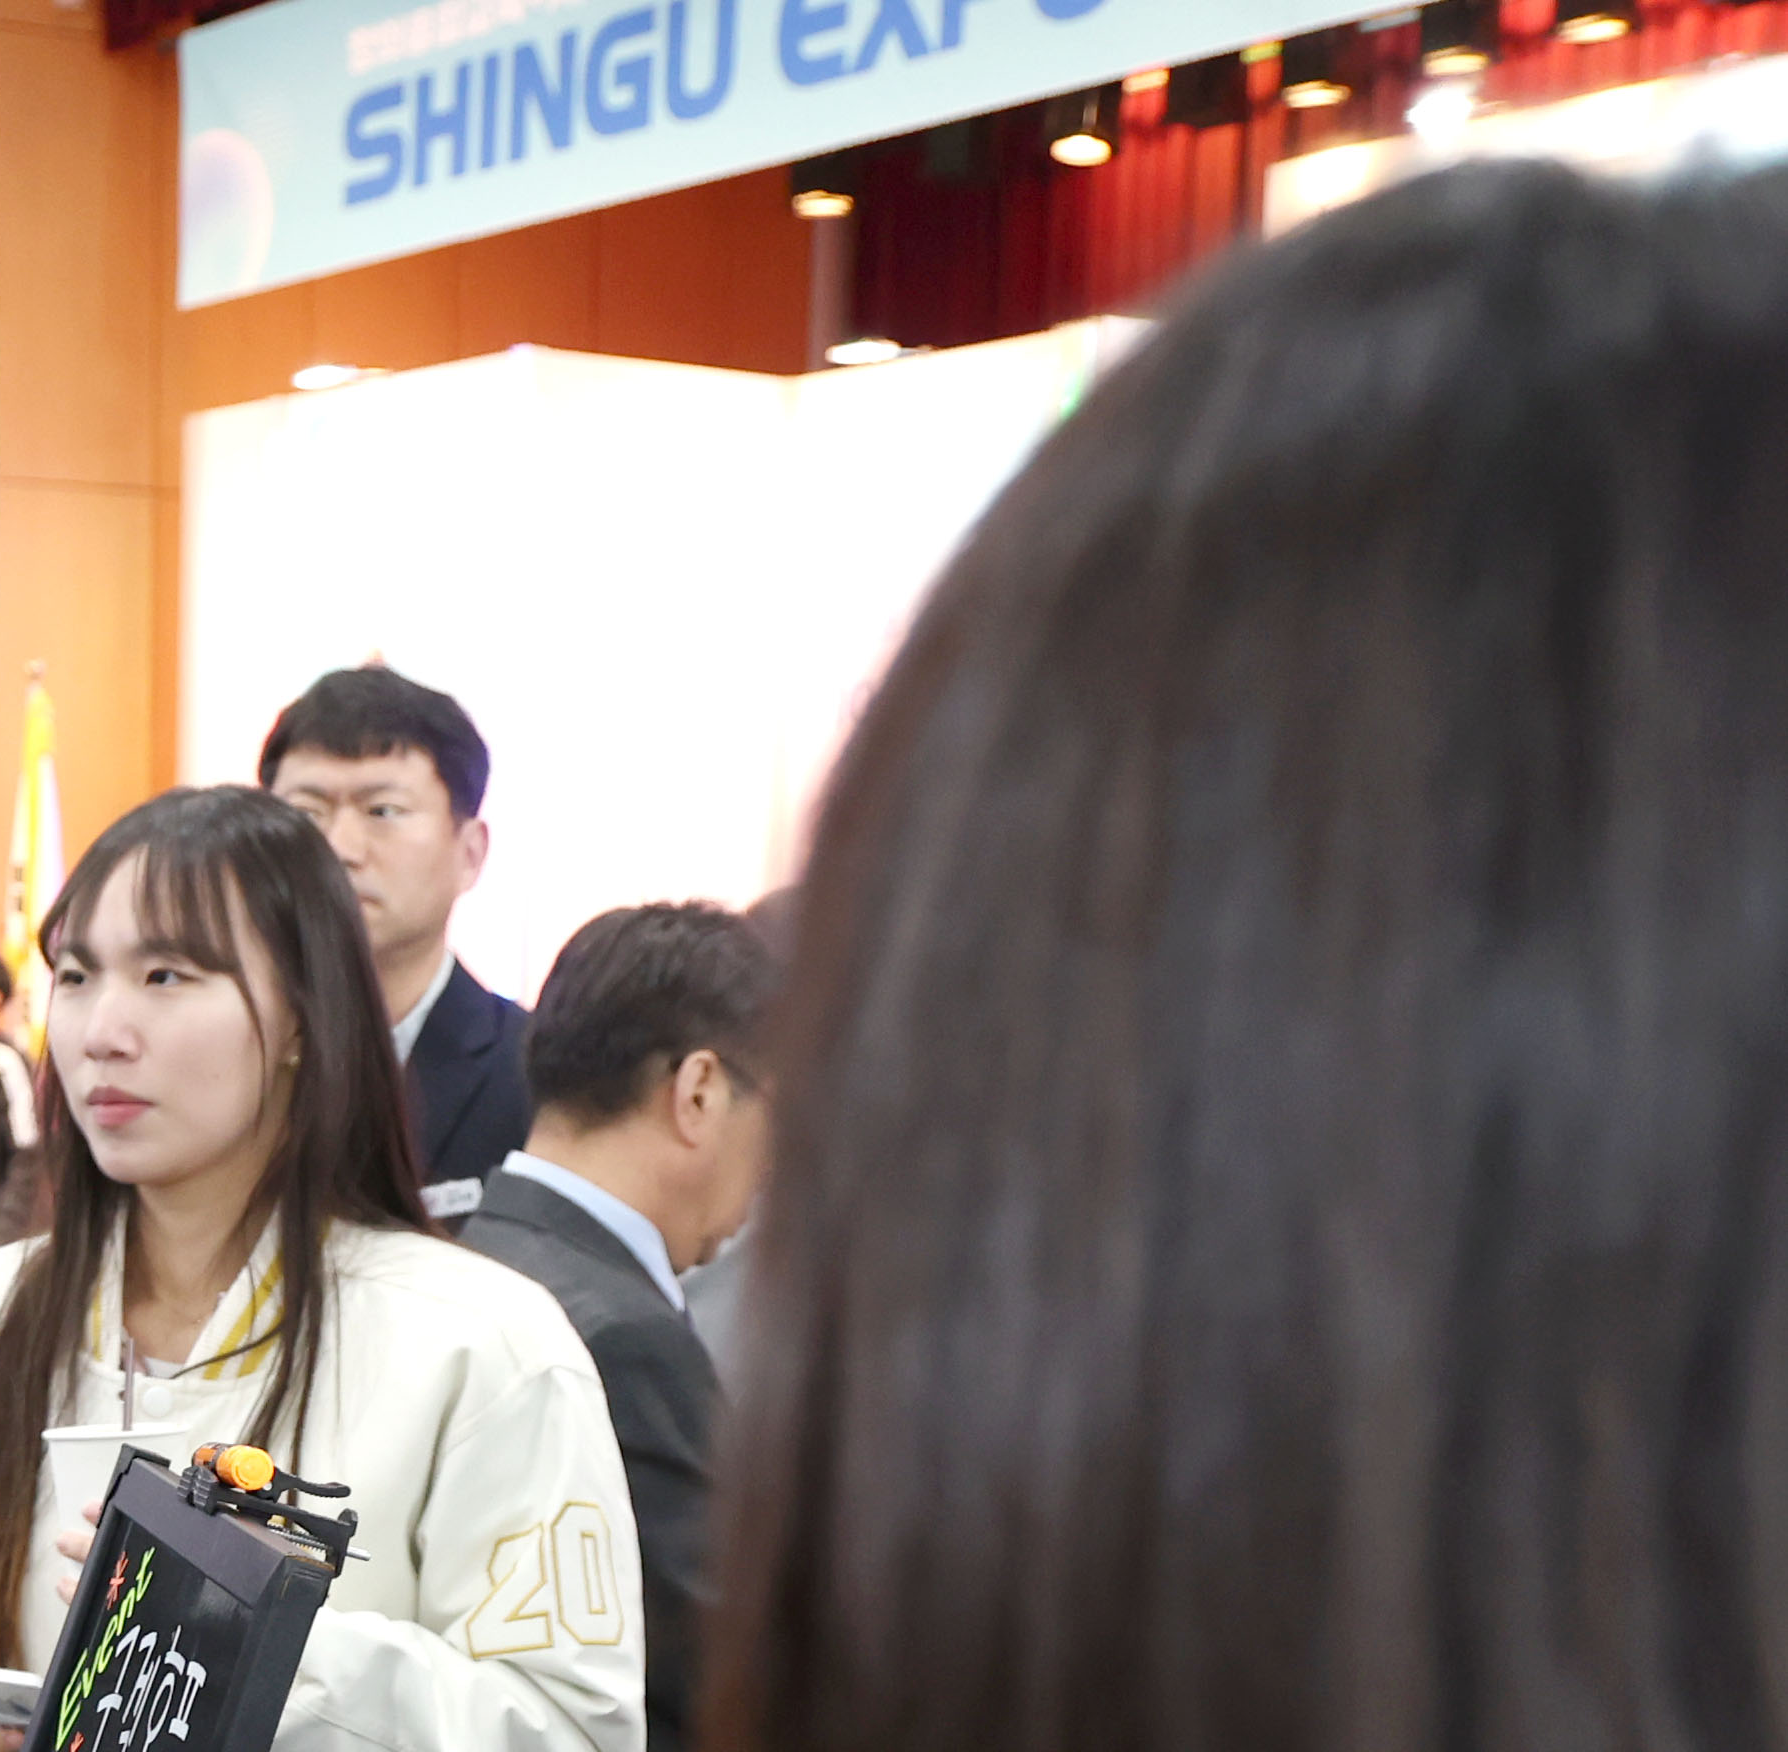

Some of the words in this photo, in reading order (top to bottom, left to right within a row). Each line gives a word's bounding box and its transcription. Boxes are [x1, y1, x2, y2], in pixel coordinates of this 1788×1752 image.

[345, 0, 739, 207] SHINGU
[54, 1547, 156, 1752] Event
[466, 1501, 625, 1661] 20
